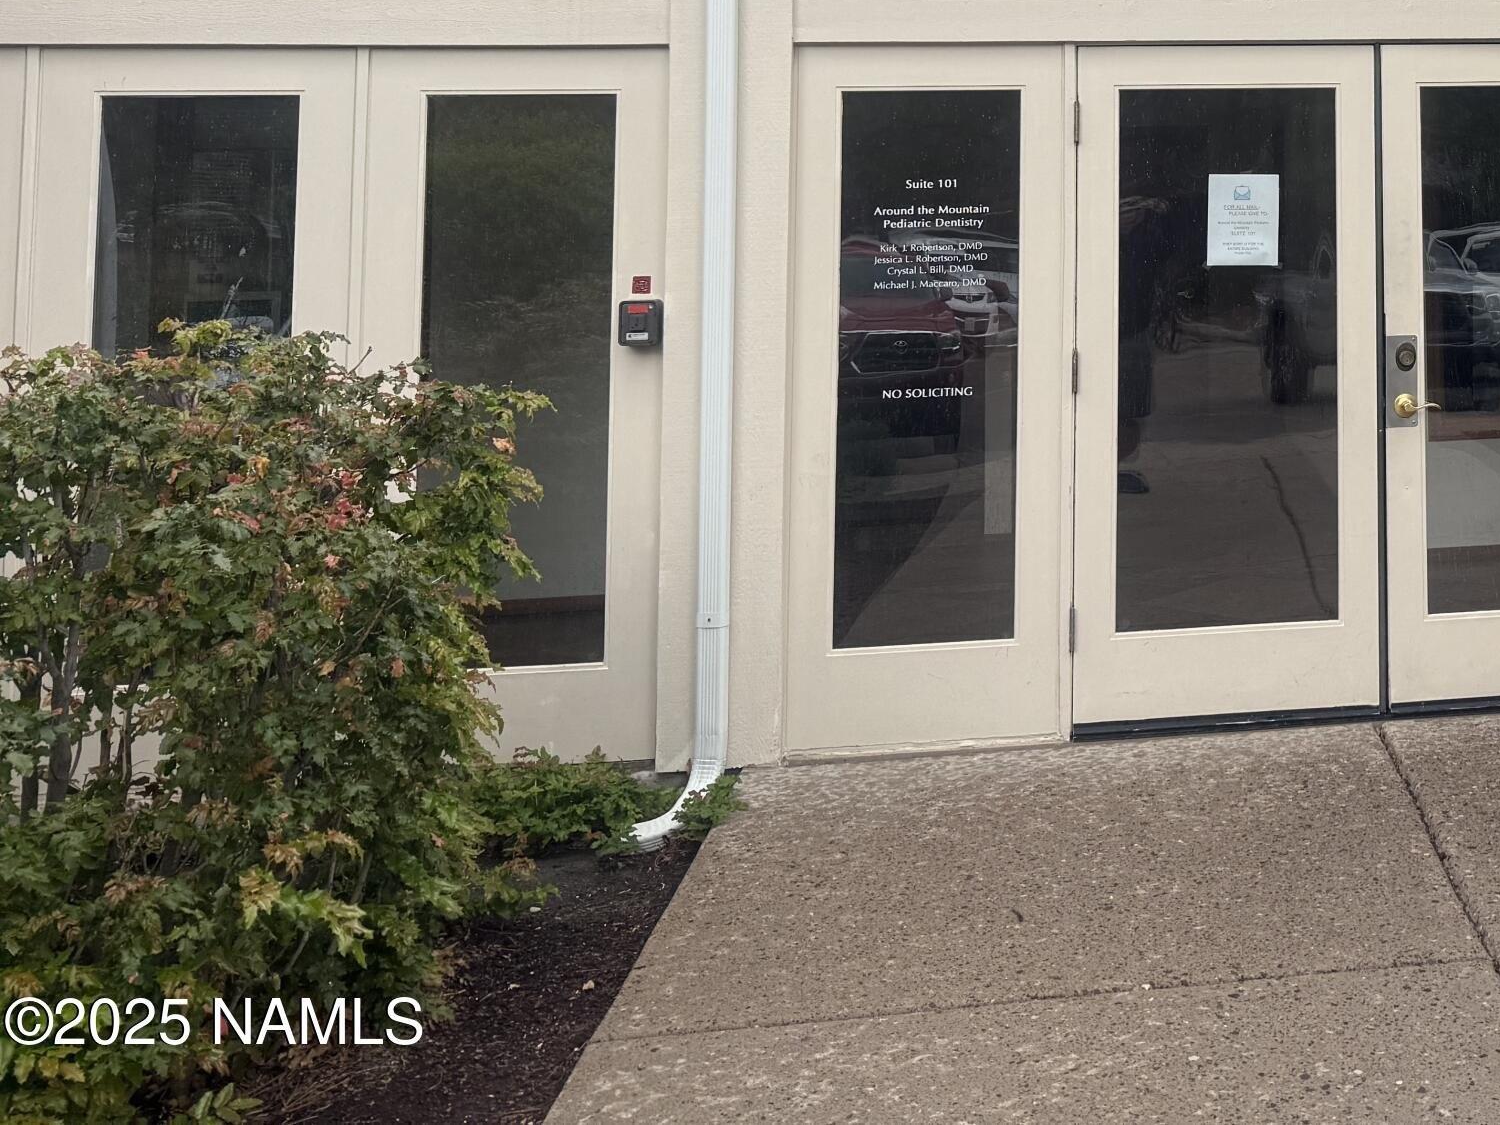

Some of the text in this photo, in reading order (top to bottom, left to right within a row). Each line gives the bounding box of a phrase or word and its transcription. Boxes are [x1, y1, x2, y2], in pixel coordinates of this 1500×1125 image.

[906, 179, 958, 189] Suite 101
[874, 204, 989, 216] Around the Mountain
[884, 218, 983, 228] Pediatric Dentistry
[880, 244, 897, 252] Kirk
[910, 243, 956, 251] Robertson,
[959, 242, 983, 250] DMD
[874, 253, 988, 265] Jessica L. Robertson, DMD
[887, 265, 973, 276] Crystal L. Bill, DMD
[874, 280, 909, 289] Michael
[911, 281, 917, 289] J.
[962, 278, 986, 286] DMD
[883, 387, 973, 399] NO SOLICITING
